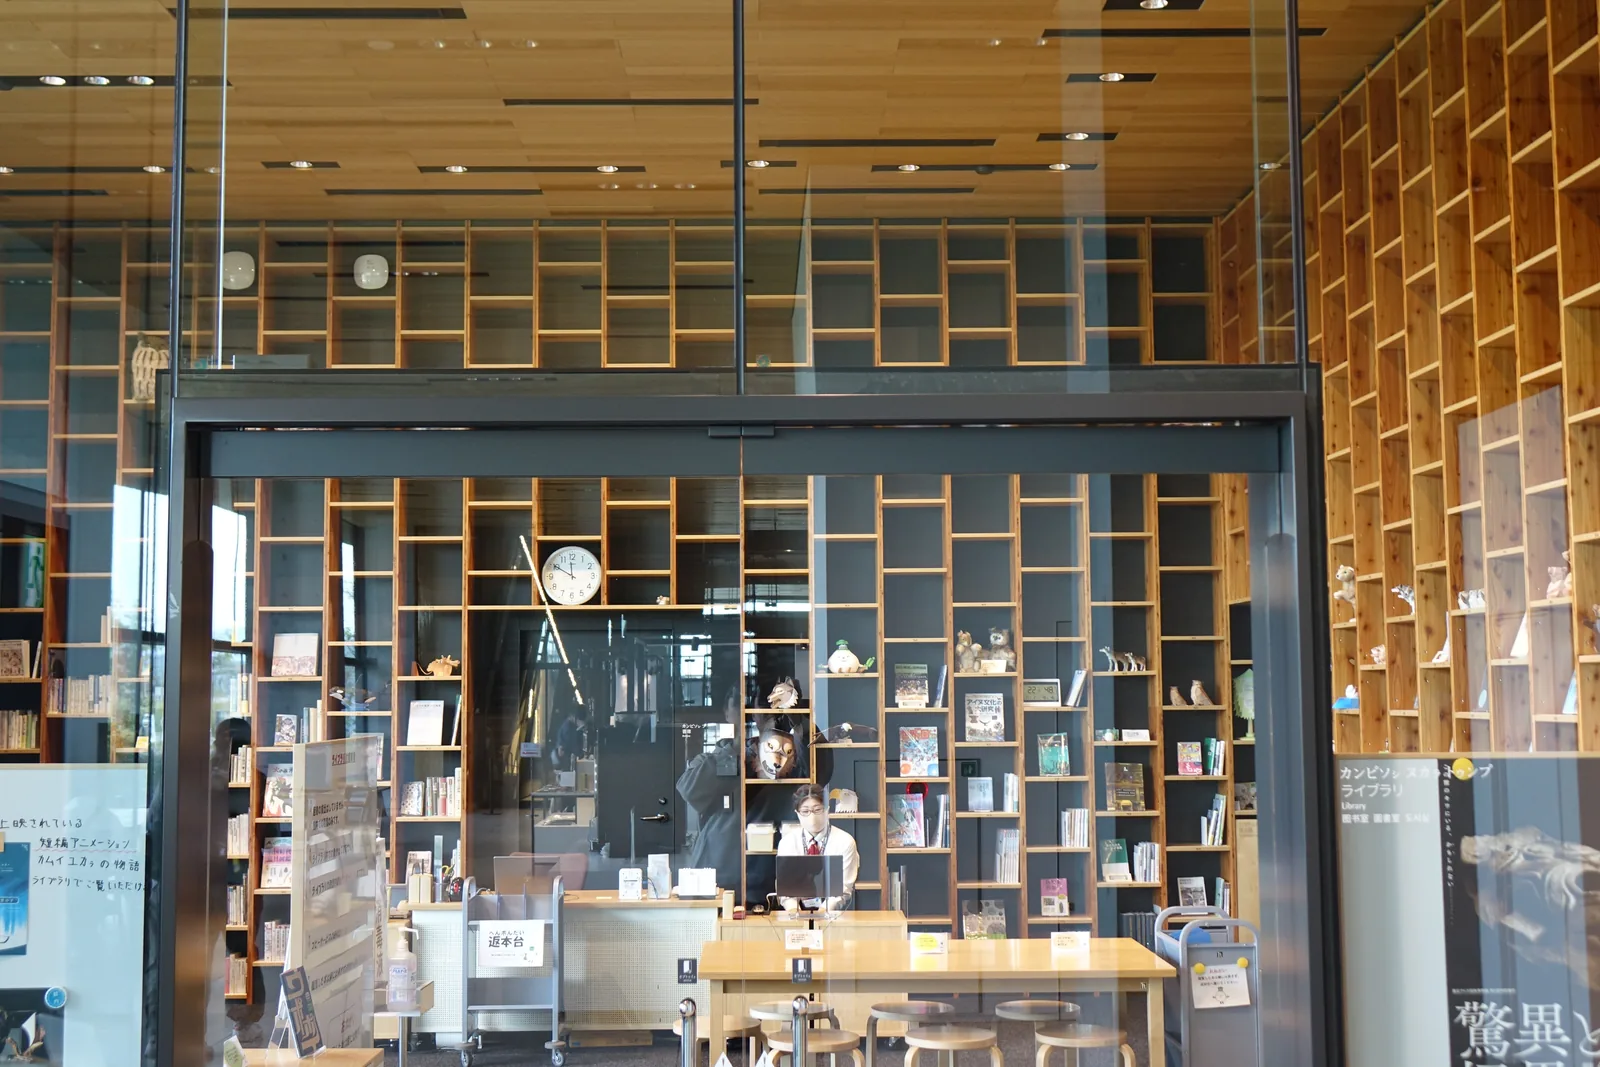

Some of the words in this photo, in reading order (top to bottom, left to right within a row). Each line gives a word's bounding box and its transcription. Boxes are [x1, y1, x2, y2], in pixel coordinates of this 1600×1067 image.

[1341, 784, 1403, 797] ライブラリ
[1341, 801, 1366, 811] Library
[0, 818, 83, 829] 上映されている
[39, 837, 131, 849] 短編アニメーション
[488, 935, 524, 948] 返本台
[1453, 1001, 1600, 1058] 驚異と
